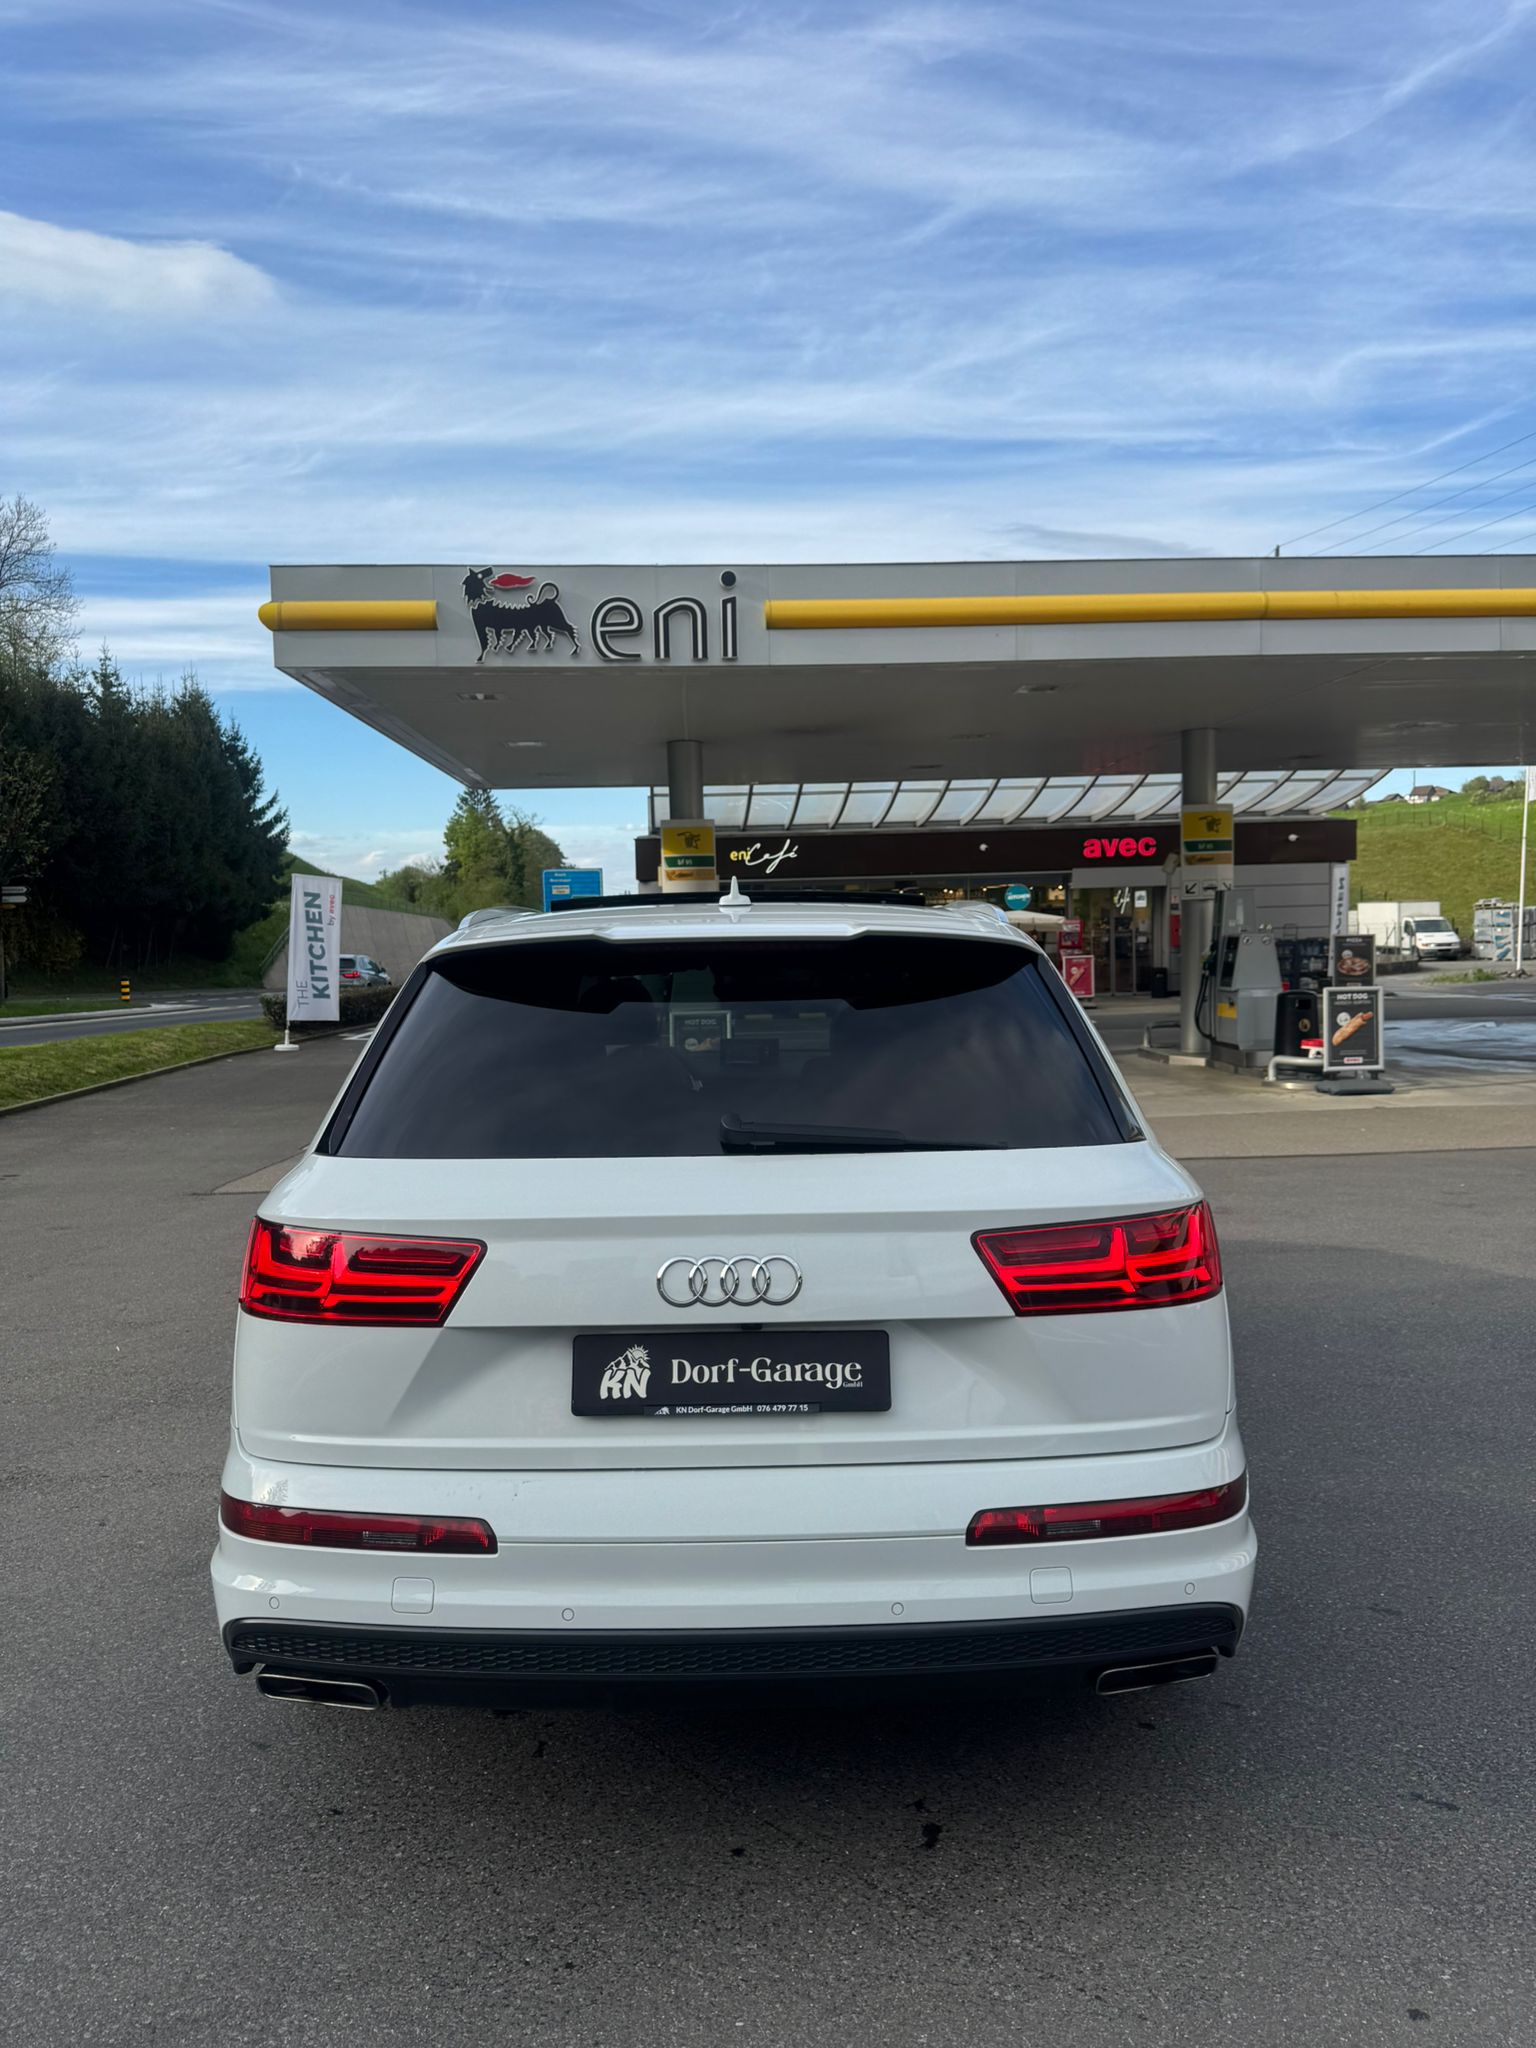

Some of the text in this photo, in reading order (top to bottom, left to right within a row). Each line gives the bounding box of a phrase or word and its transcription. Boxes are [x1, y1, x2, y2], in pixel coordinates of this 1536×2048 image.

[591, 570, 738, 660] eni
[1083, 837, 1157, 858] avec
[328, 915, 336, 926] by
[303, 891, 331, 999] KITCHEN
[296, 980, 309, 1008] THE
[1353, 992, 1368, 1000] DOG
[600, 1367, 651, 1400] KN
[671, 1357, 863, 1390] Dorf-Garage
[676, 1406, 687, 1414] KN
[688, 1405, 730, 1414] Dorf-Garage
[757, 1404, 771, 1412] 076
[772, 1404, 786, 1412] 479
[799, 1404, 809, 1412] 15
